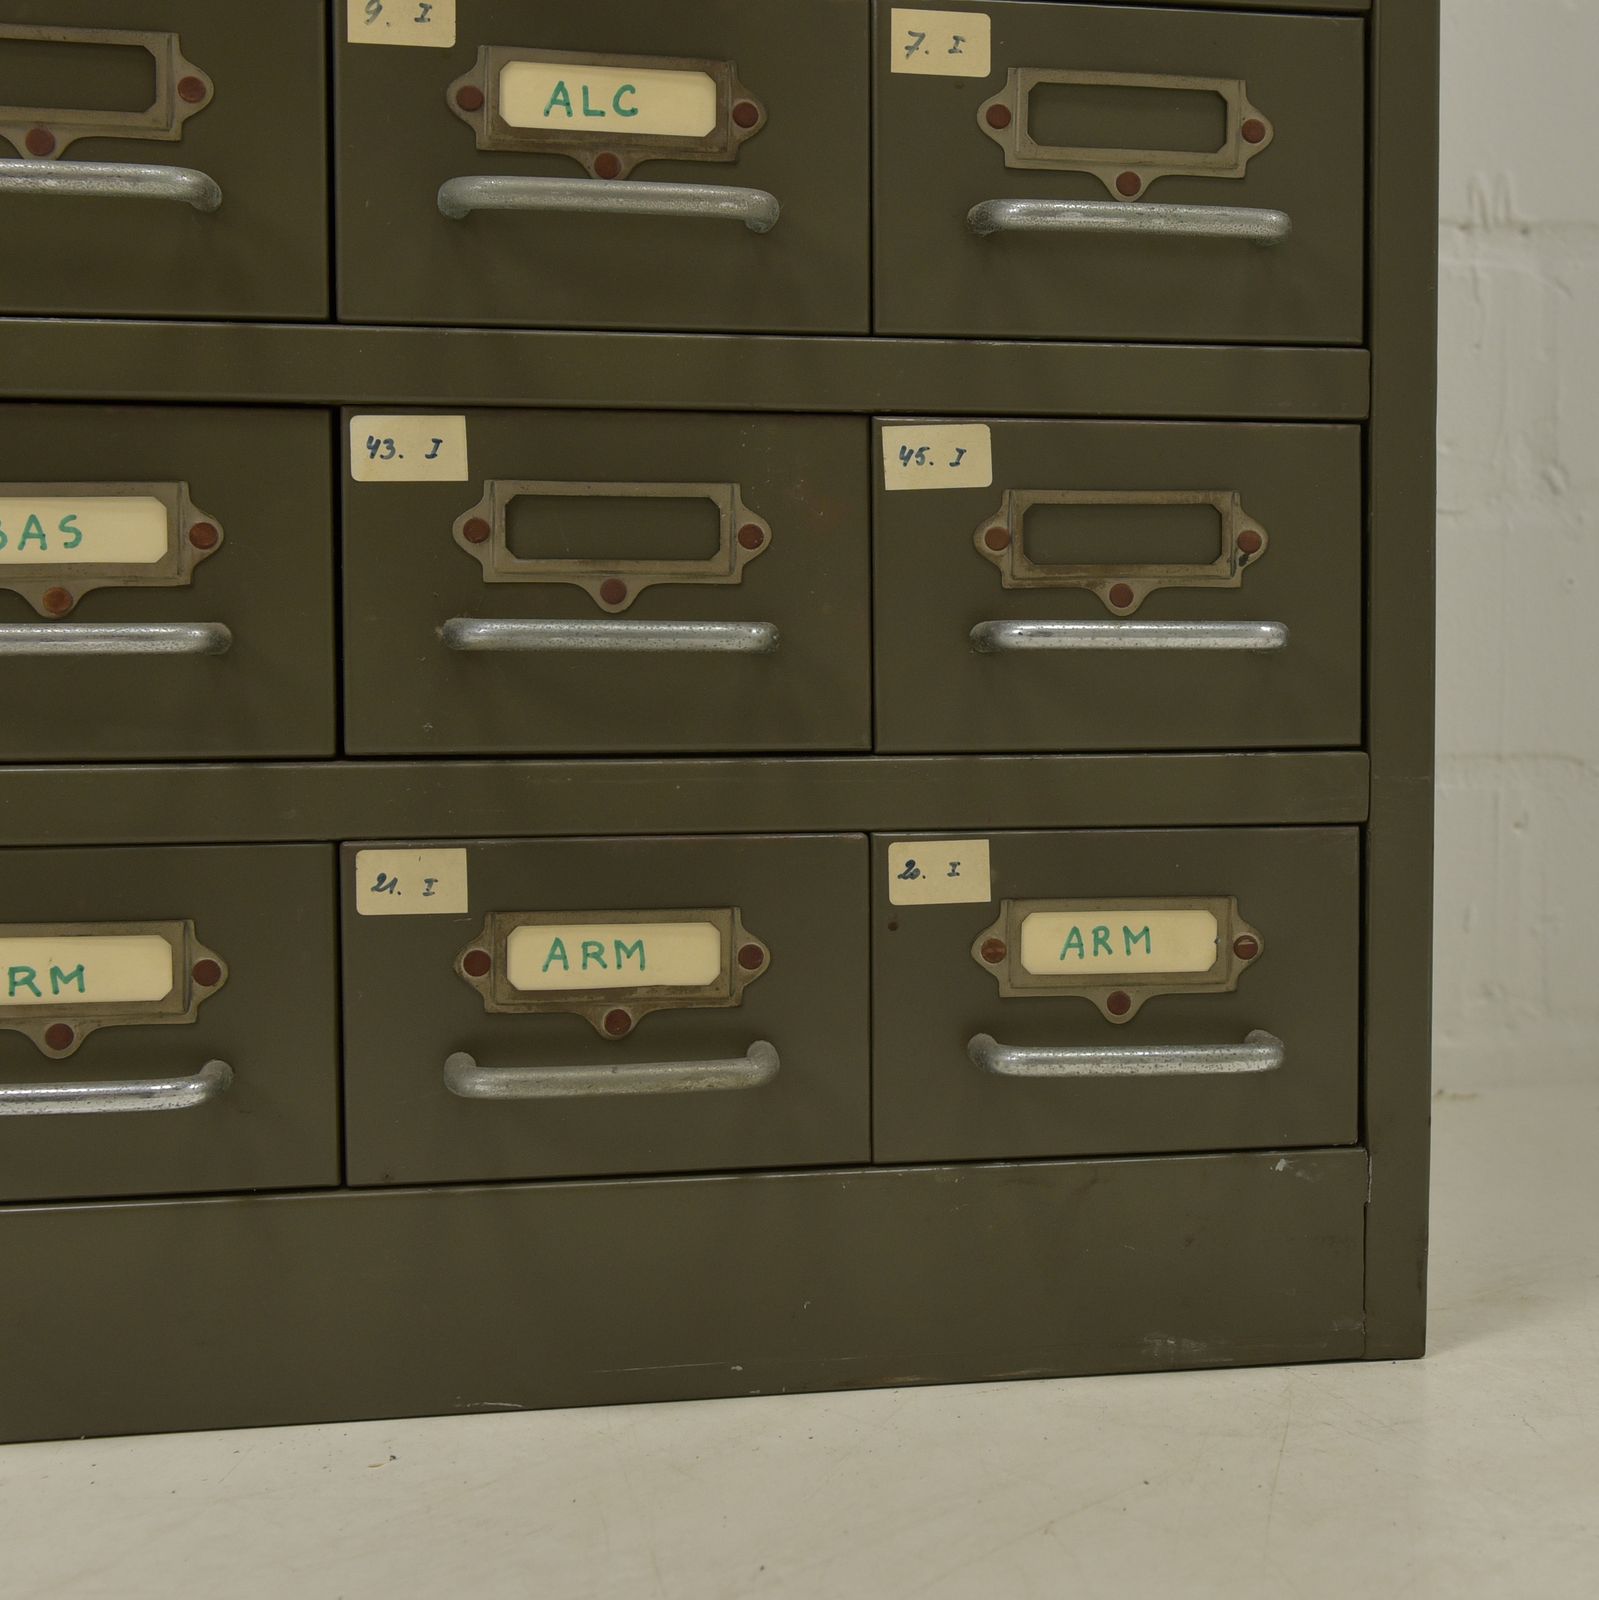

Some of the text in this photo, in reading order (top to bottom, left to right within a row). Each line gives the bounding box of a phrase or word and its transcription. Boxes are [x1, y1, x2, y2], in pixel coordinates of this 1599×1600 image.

[905, 31, 967, 59] 7. I
[544, 80, 639, 118] ALC
[366, 436, 443, 460] 43. I
[898, 444, 968, 468] 45. I
[946, 861, 961, 878] I
[371, 872, 439, 897] 21. I
[542, 936, 646, 973] ARM
[1060, 925, 1152, 961] ARM
